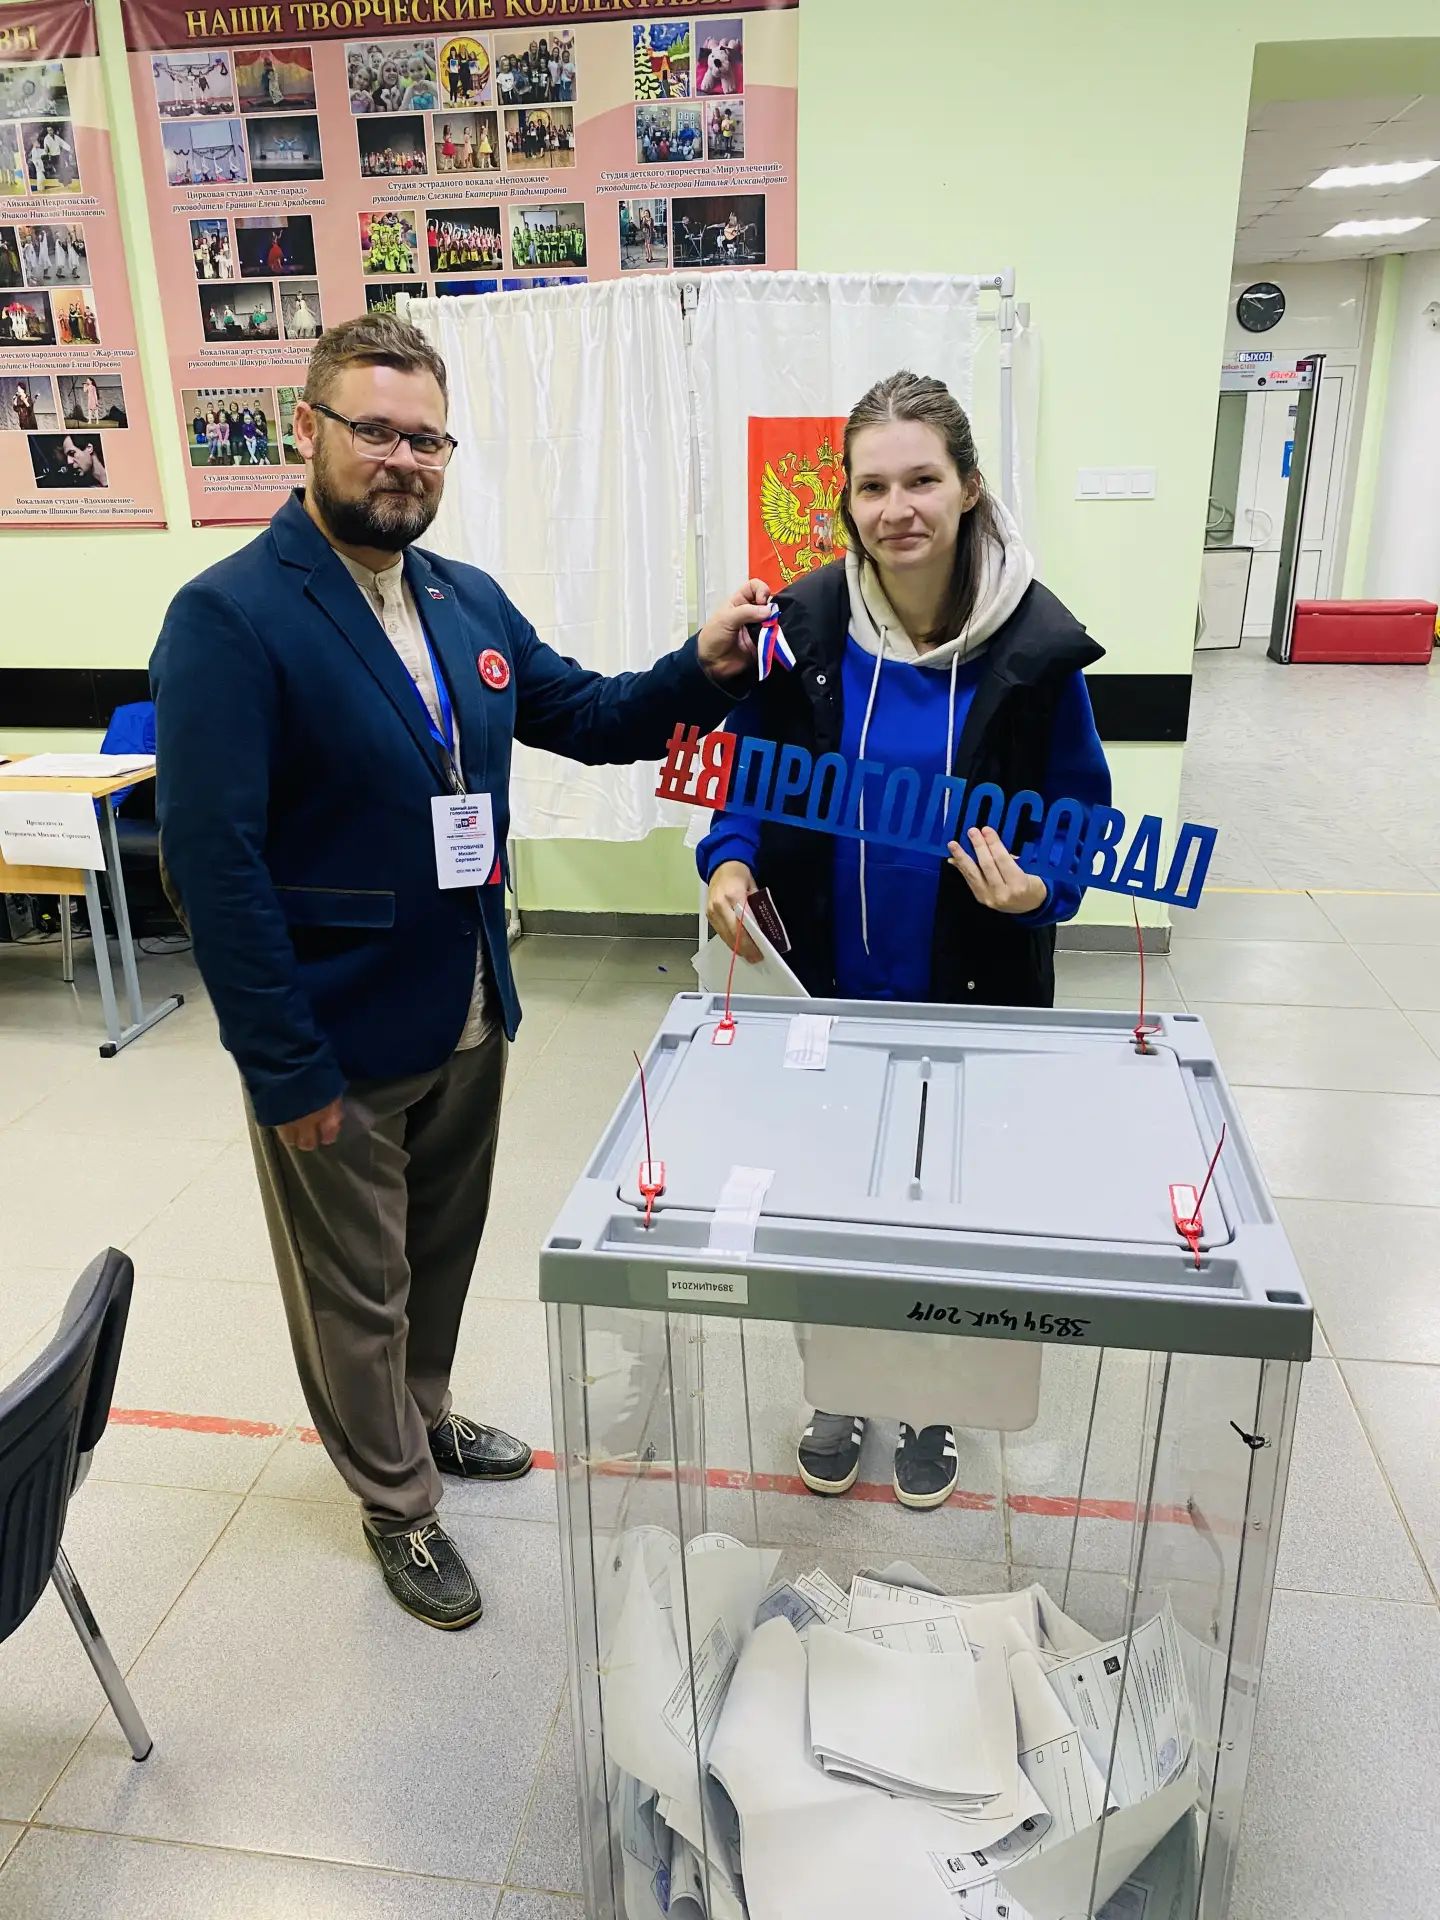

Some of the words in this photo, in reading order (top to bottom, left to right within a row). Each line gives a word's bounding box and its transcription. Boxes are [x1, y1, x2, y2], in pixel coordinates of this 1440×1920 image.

[186, 5, 285, 38] НАШИ
[290, 0, 496, 33] ТВОРЧЕСКИЕ
[600, 171, 629, 180] Студия
[630, 169, 665, 179] детского
[666, 167, 710, 177] творчества
[388, 181, 417, 190] Студия
[418, 179, 464, 189] эстрадного
[465, 178, 494, 187] вокала
[596, 182, 648, 193] руководитель
[649, 180, 692, 190] Белозерова
[693, 178, 728, 188] Наталья
[730, 175, 788, 186] Александровна
[187, 191, 225, 200] Цирковая
[226, 190, 253, 198] студия
[372, 194, 426, 204] руководитель
[465, 190, 508, 200] Екатерина
[510, 186, 567, 197] Владимировна
[172, 202, 224, 213] руководитель
[258, 200, 281, 208] Елена
[282, 198, 325, 208] Аркадьевна
[31, 351, 68, 359] народного
[69, 350, 89, 358] танца
[200, 347, 239, 356] Вокальная
[283, 346, 312, 354] «Даров
[1239, 352, 1271, 362] ВЫХОД
[92, 360, 121, 369] Юрьевна
[188, 359, 237, 369] руководитель
[268, 357, 302, 366] Людмила
[230, 473, 279, 482] дошкольного
[204, 484, 252, 493] руководитель
[16, 497, 53, 505] Вокальная
[54, 498, 79, 506] студия
[1, 507, 48, 516] руководитель
[671, 1281, 734, 1293] 3894ЦИК2014
[906, 1301, 961, 1325] 2014
[1024, 1311, 1091, 1337] 3894
